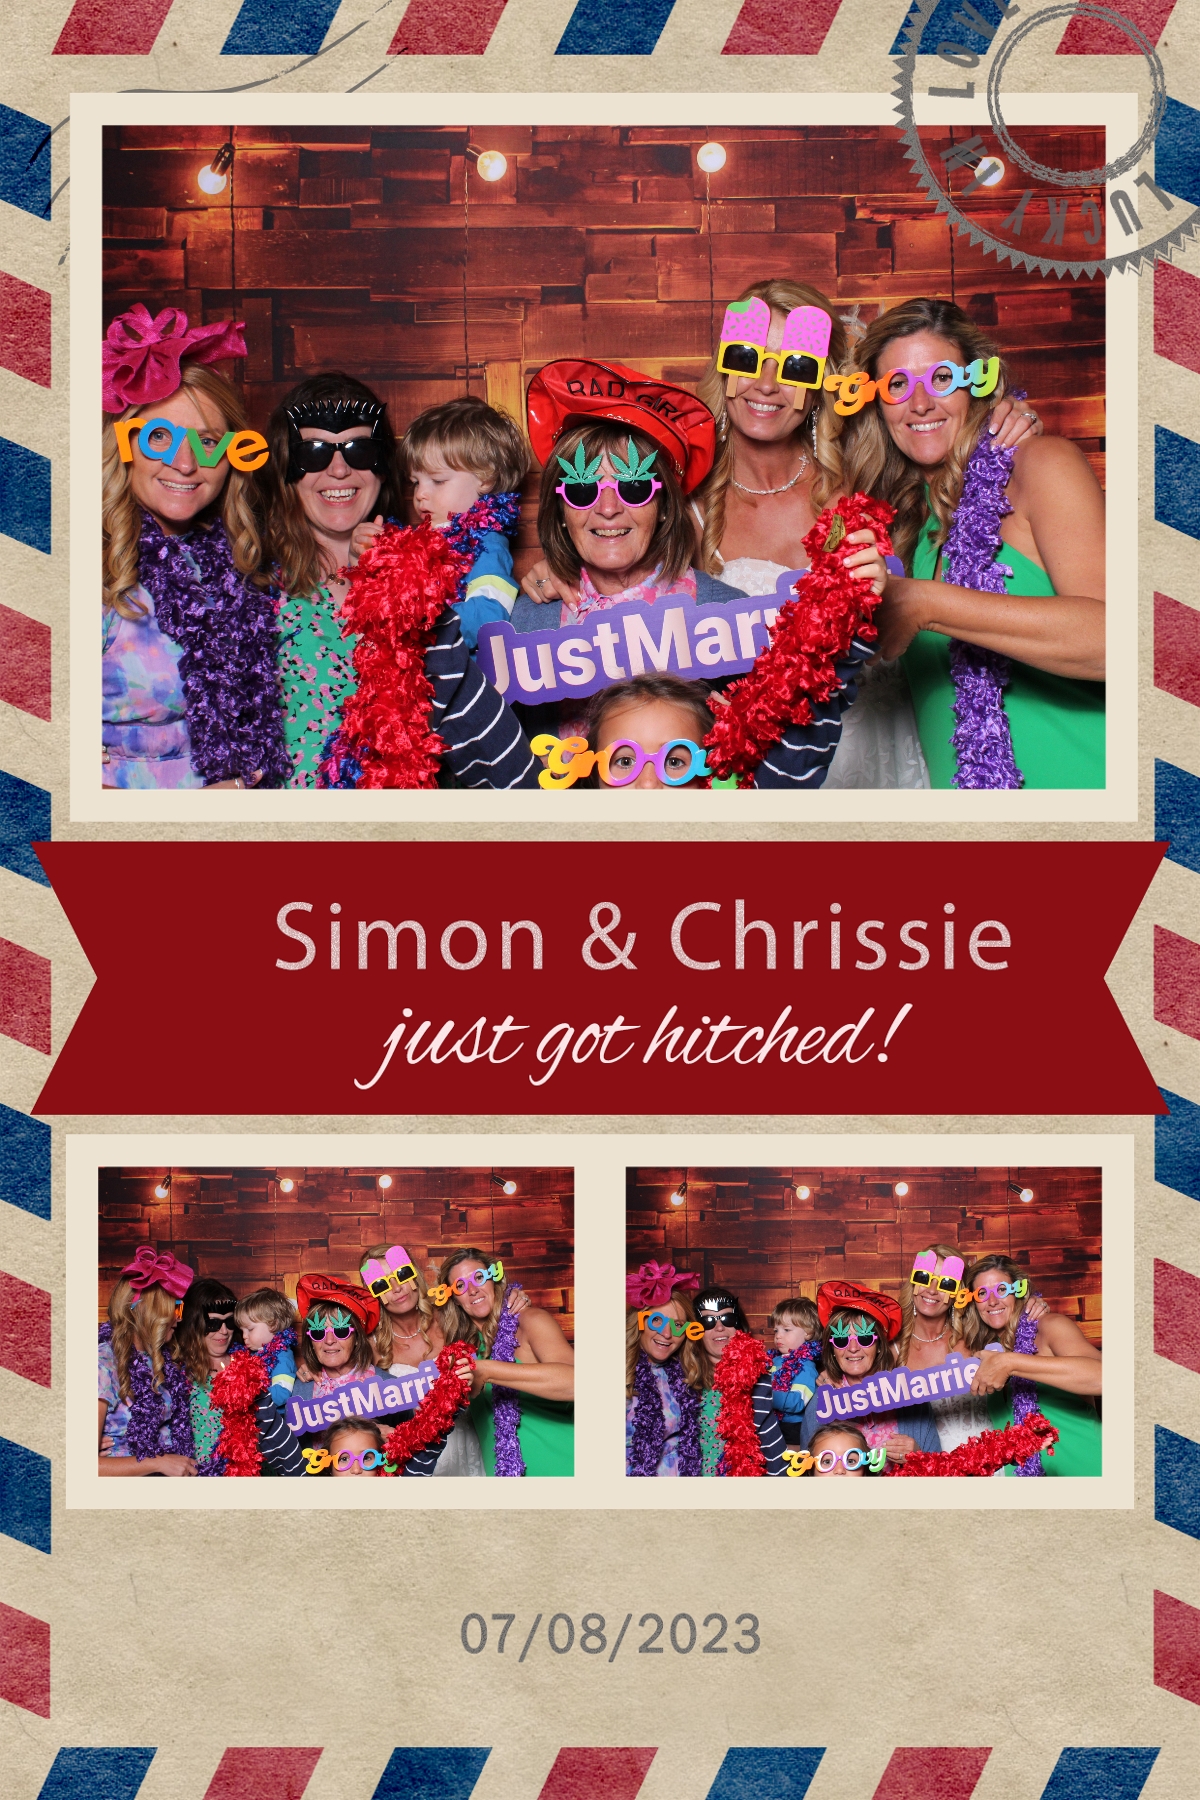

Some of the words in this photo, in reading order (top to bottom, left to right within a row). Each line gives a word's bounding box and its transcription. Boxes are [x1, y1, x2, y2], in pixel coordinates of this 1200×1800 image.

[113, 417, 270, 472] rave
[490, 585, 800, 696] JustMar
[637, 1310, 705, 1341] rave
